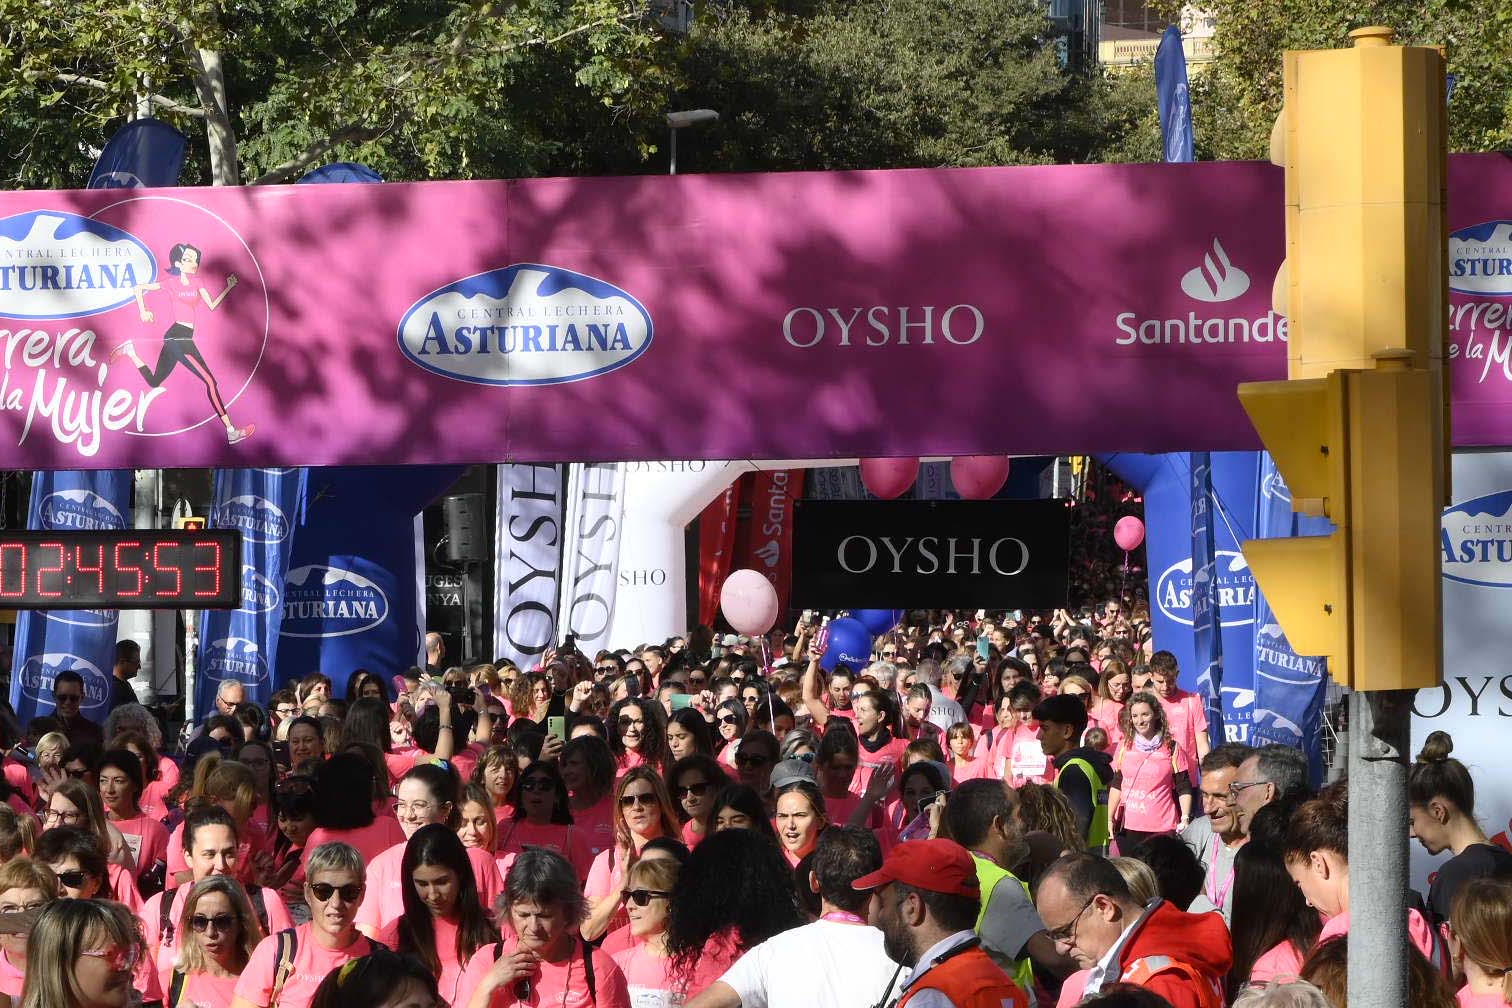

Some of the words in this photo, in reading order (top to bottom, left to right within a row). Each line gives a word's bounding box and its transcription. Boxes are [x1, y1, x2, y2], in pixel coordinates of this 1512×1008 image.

[58, 246, 132, 259] LECHERA
[1447, 258, 1512, 276] STUR
[1457, 247, 1507, 255] CENTRAL
[457, 308, 534, 320] CENTRAL
[544, 306, 624, 318] LECHERA
[782, 303, 985, 350] OYSHO
[1115, 310, 1289, 346] Santande
[417, 311, 633, 356] ASTURIANA
[1466, 332, 1483, 359] la
[0, 370, 24, 412] la
[17, 361, 166, 457] Mujer
[763, 471, 788, 537] Santa
[1441, 527, 1512, 564] ASTU
[1462, 524, 1512, 534] CENTR
[506, 464, 558, 656] OYSH
[569, 464, 619, 642] OYSH
[837, 535, 1030, 577] OYSHO
[285, 589, 322, 598] ENTRAL
[326, 589, 375, 598] LECHERA
[619, 568, 667, 587] SHO
[280, 601, 380, 620] STURIANA
[1256, 645, 1323, 678] TURIANA
[1410, 674, 1512, 719] OYS
